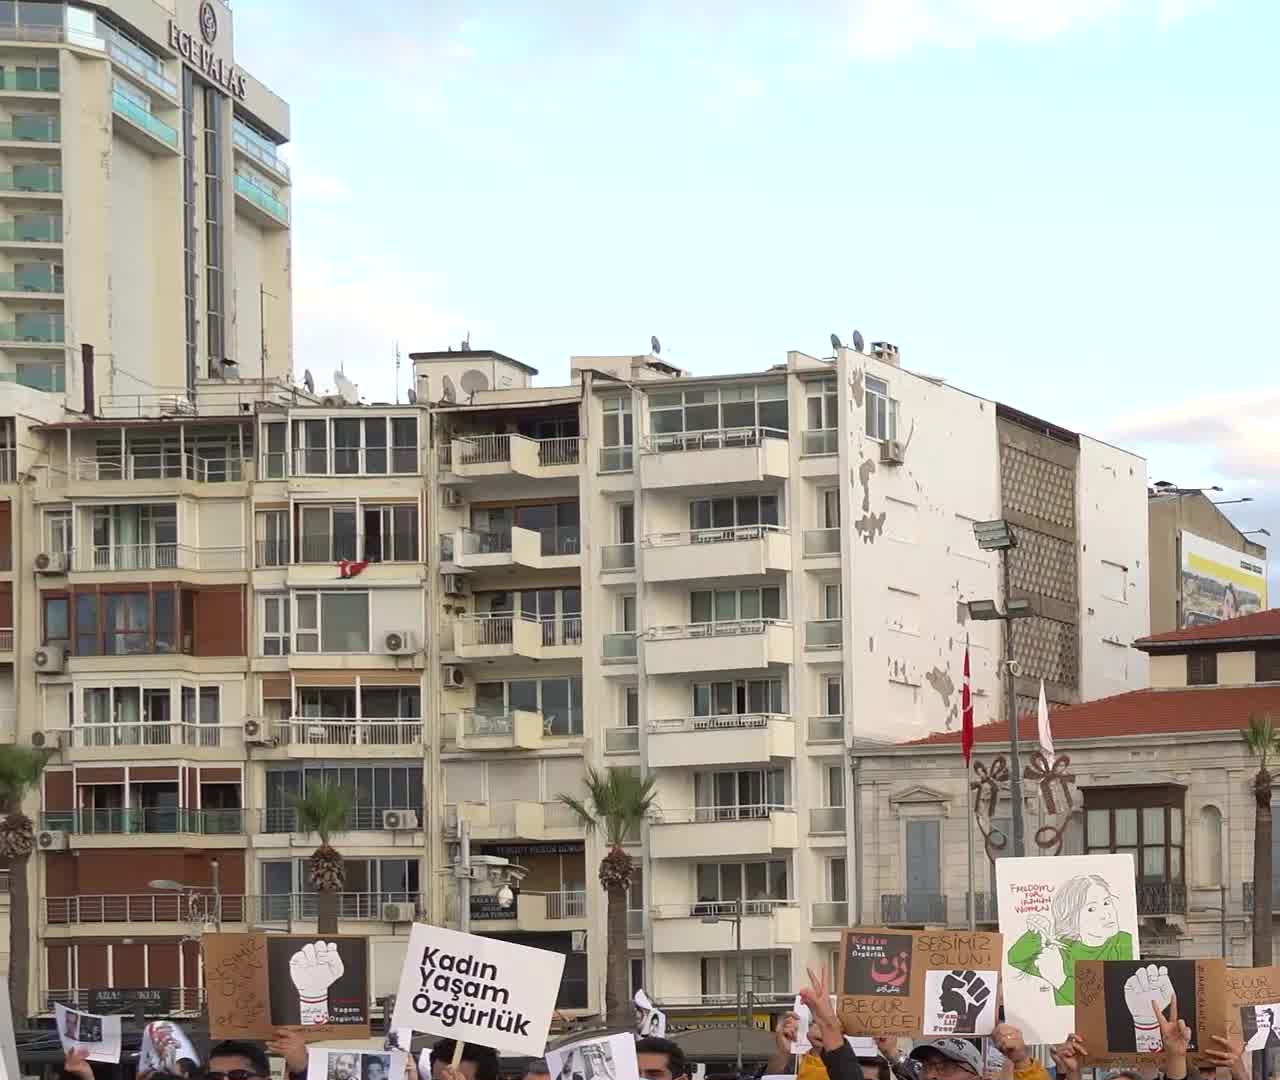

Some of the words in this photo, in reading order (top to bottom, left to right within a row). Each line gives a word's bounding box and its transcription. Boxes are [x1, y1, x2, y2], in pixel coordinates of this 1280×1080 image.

[421, 946, 498, 981] Kadın
[929, 952, 992, 968] OLUN!
[419, 966, 510, 1005] Yaşam
[411, 987, 532, 1037] Özgürlük
[841, 999, 866, 1014] BE
[857, 1014, 922, 1031] VOICE!
